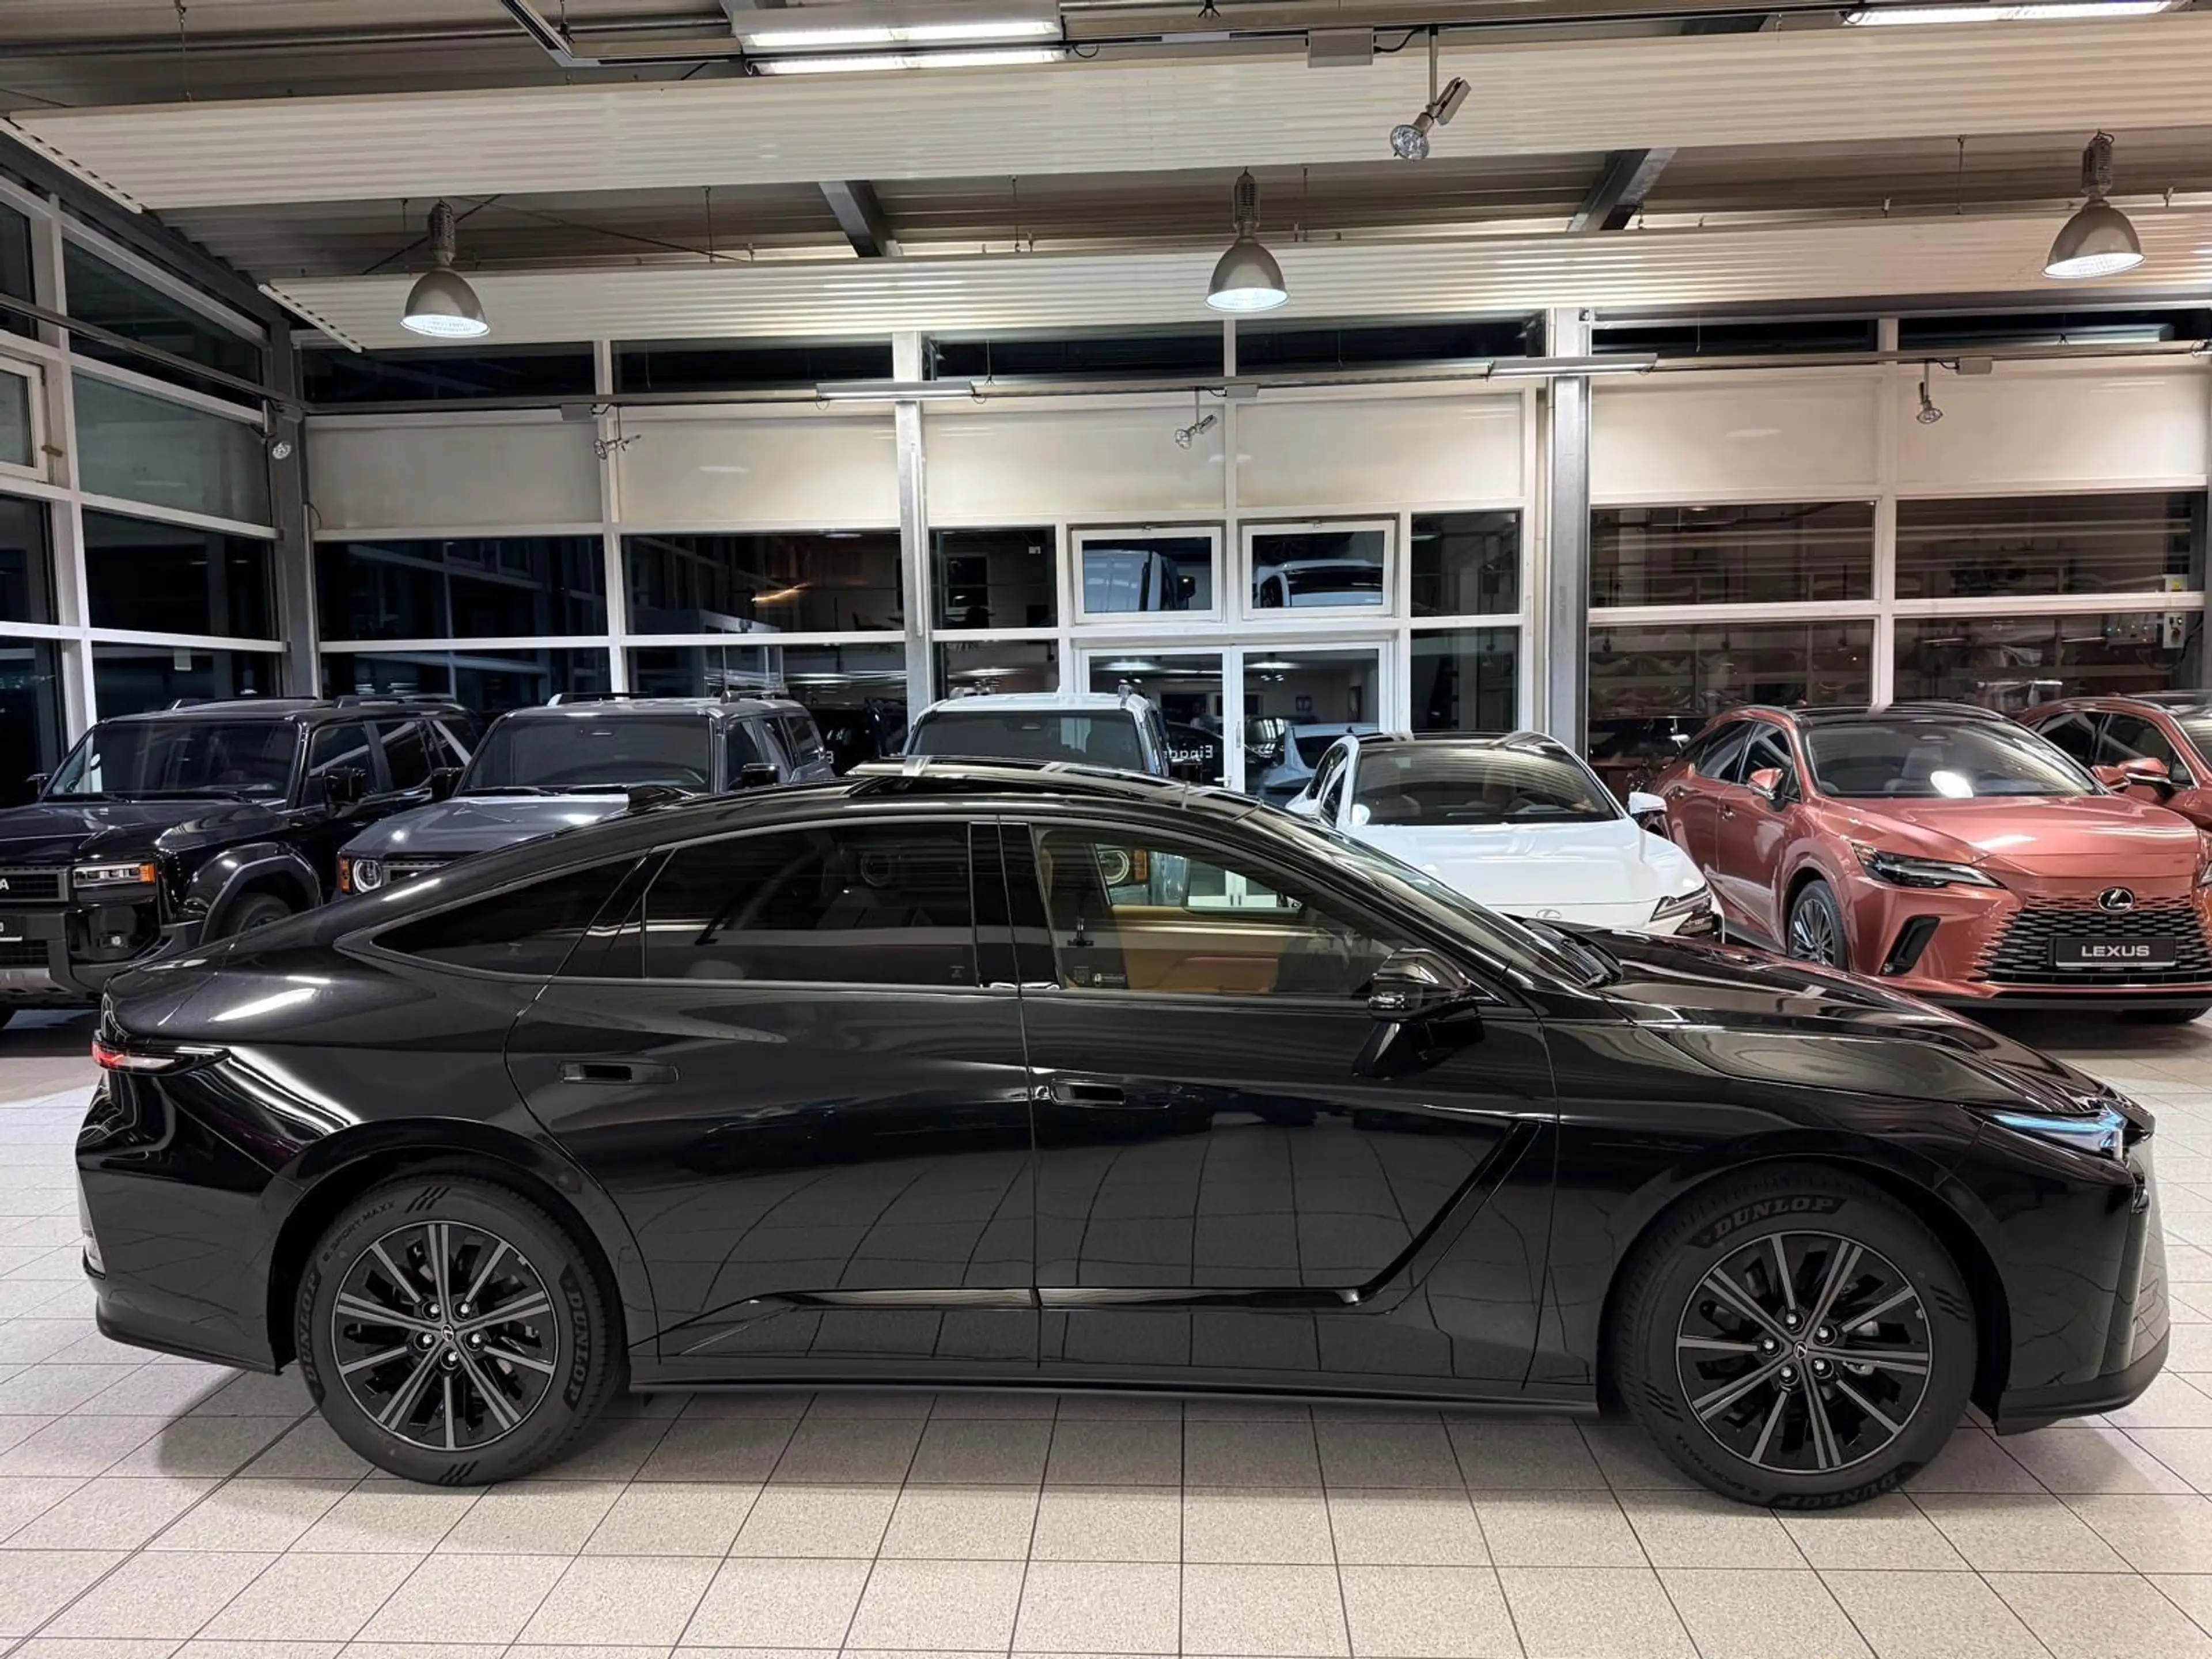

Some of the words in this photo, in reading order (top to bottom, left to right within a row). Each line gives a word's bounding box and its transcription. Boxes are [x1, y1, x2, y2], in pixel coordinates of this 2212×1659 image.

[2081, 945, 2150, 957] LEXUS
[362, 1200, 395, 1221] MAXX
[1714, 1197, 1834, 1238] DUNLOP
[298, 1271, 319, 1383] DUNLOP
[567, 1291, 589, 1401] DUNLOP
[1776, 1471, 1897, 1508] DUNLOP
